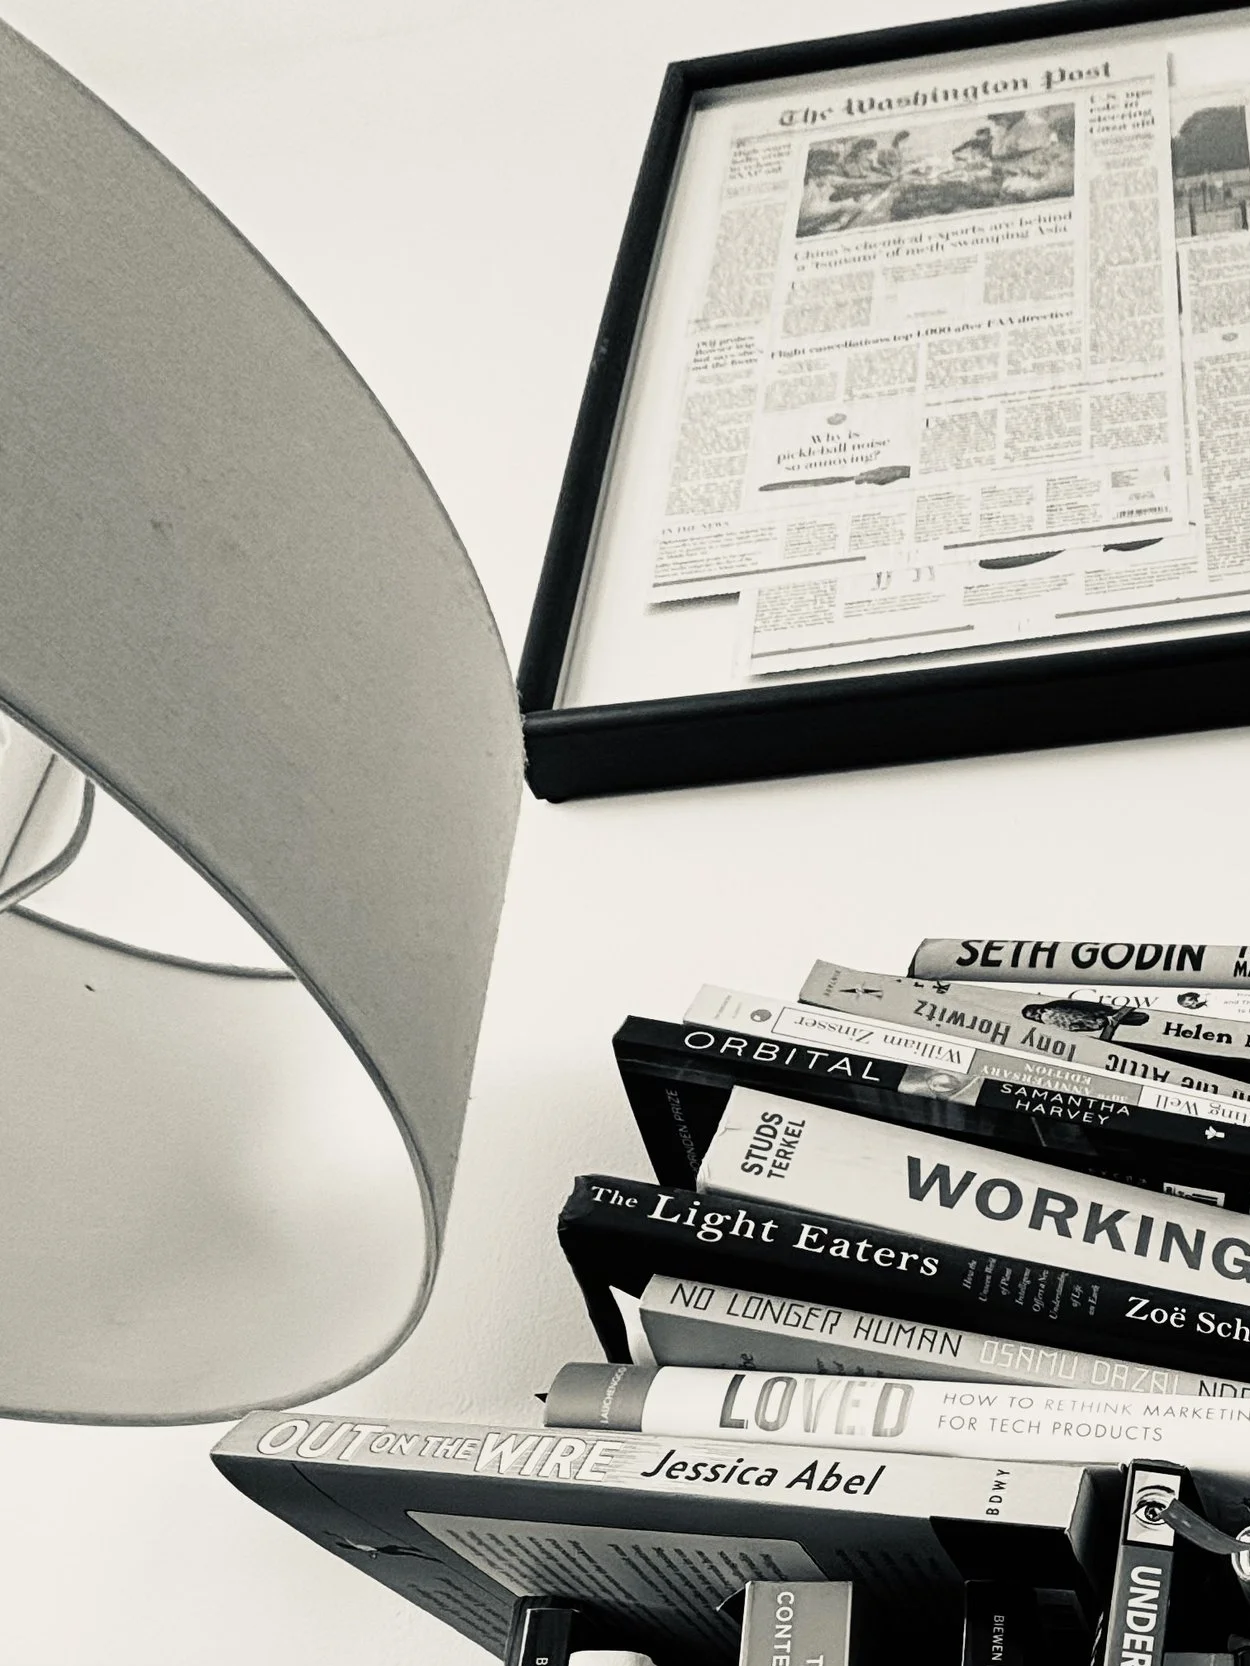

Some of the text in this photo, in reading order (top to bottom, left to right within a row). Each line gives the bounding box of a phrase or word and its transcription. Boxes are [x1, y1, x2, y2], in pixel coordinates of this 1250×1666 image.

[846, 77, 1030, 116] Washington
[1044, 61, 1111, 90] Post
[792, 1014, 962, 1066] William Zinsser
[912, 998, 1077, 1061] Tony Horwitz
[1162, 1021, 1234, 1045] Helen
[683, 1030, 882, 1083] ORBITAL
[1000, 1082, 1132, 1118] SAMANTHA
[1015, 1098, 1111, 1127] HARVEY
[1156, 1092, 1200, 1117] Well
[739, 1110, 784, 1177] STUDS
[767, 1117, 806, 1182] TERKEL
[591, 1185, 941, 1278] The Light Eaters
[669, 1282, 716, 1312] NO
[726, 1291, 843, 1336] LONGER
[853, 1314, 963, 1359] HUMAN
[978, 1338, 1078, 1378] OSAMU
[1124, 1295, 1187, 1330] Zoë
[718, 1372, 916, 1439] LOVED
[936, 1414, 1164, 1443] FOR TECH PRODUCTS
[942, 1392, 999, 1409] HOW
[1008, 1394, 1035, 1410] TO
[1044, 1398, 1134, 1418] RETHINK
[256, 1418, 628, 1483] OUT ON THE WIRE
[640, 1448, 887, 1497] Jessica Abel
[991, 1614, 1006, 1662] BIEWEN
